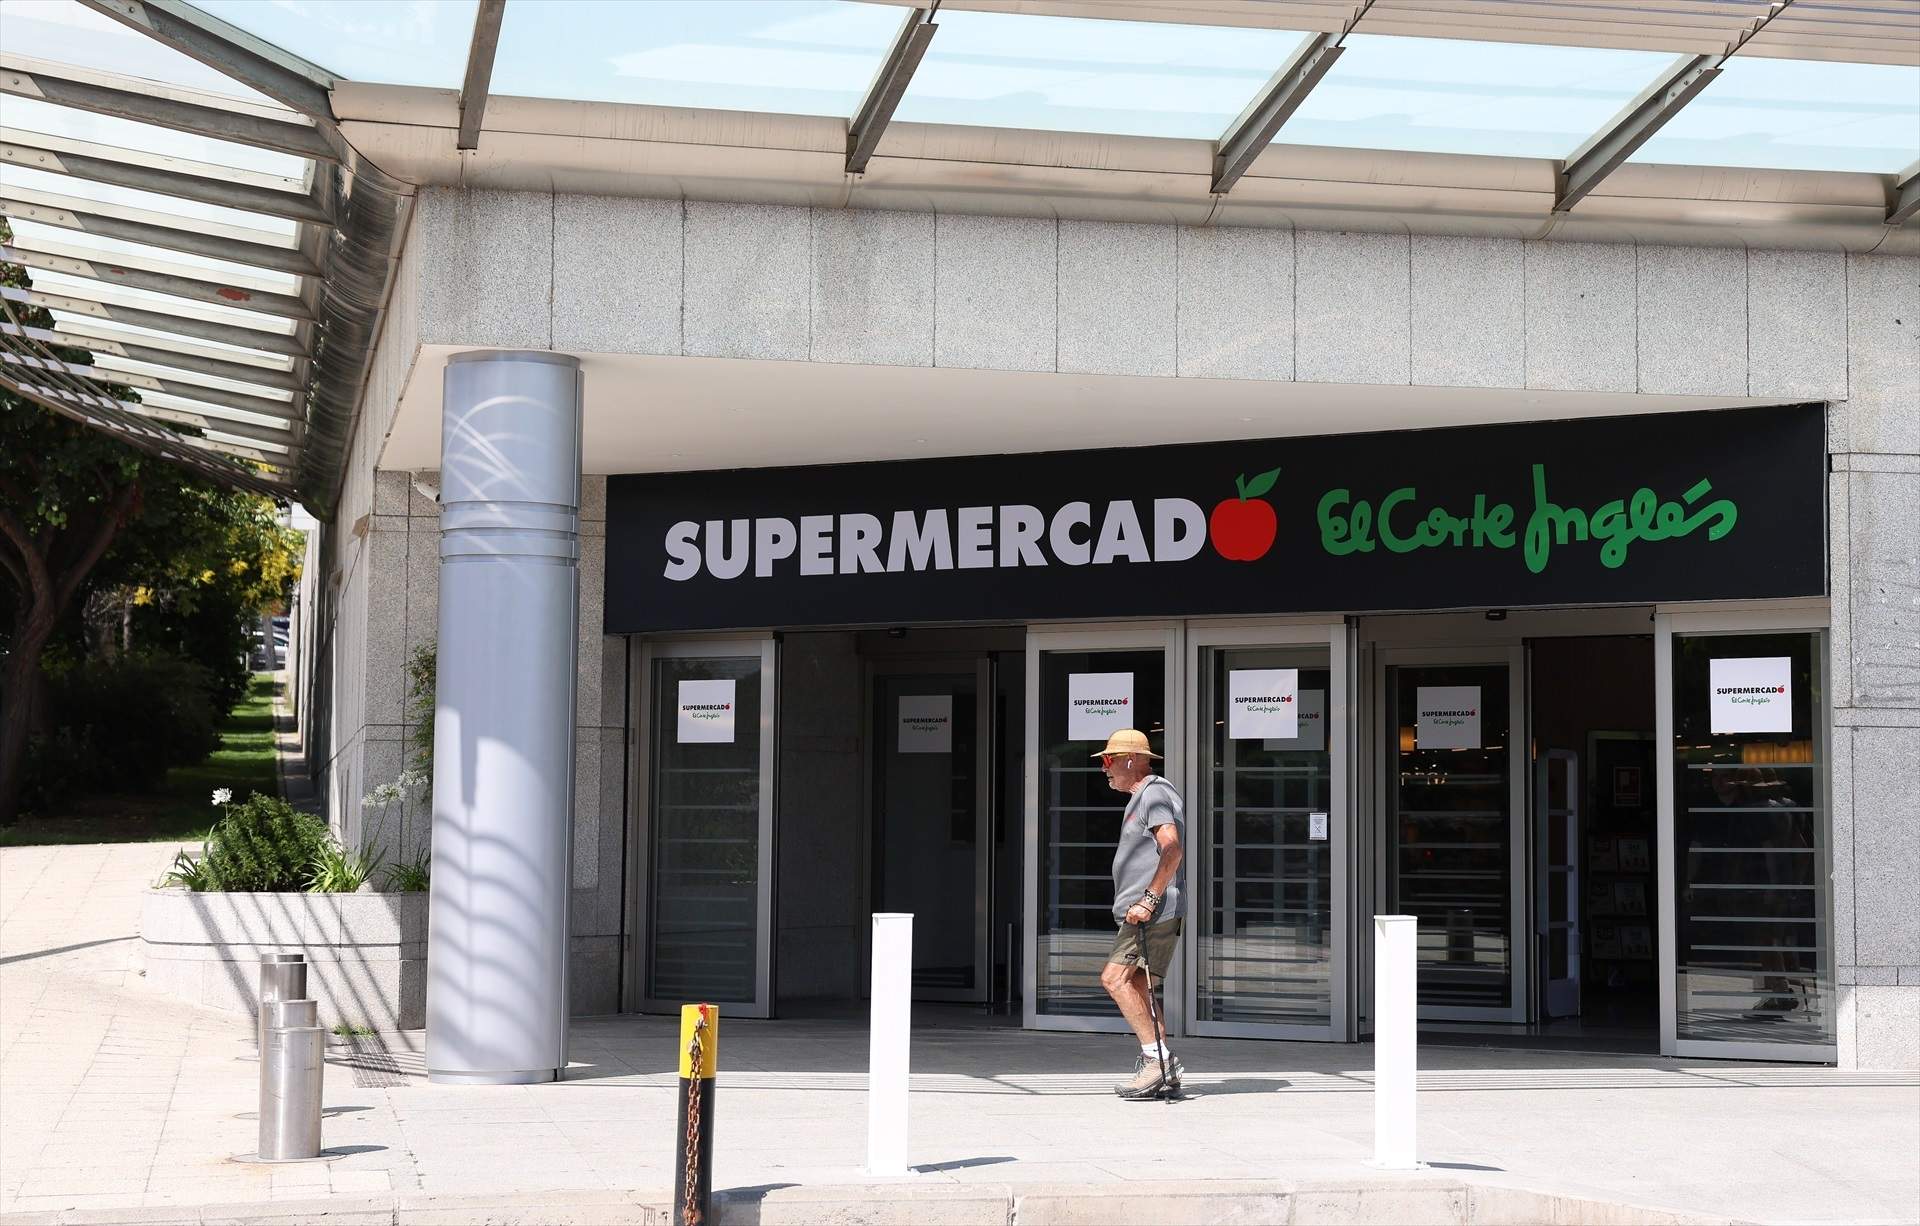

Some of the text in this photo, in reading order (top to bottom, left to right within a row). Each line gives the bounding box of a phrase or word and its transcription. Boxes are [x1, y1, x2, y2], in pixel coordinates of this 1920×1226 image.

[1316, 488, 1375, 556] El
[1377, 487, 1516, 554] Corte
[1524, 464, 1738, 573] Inglés
